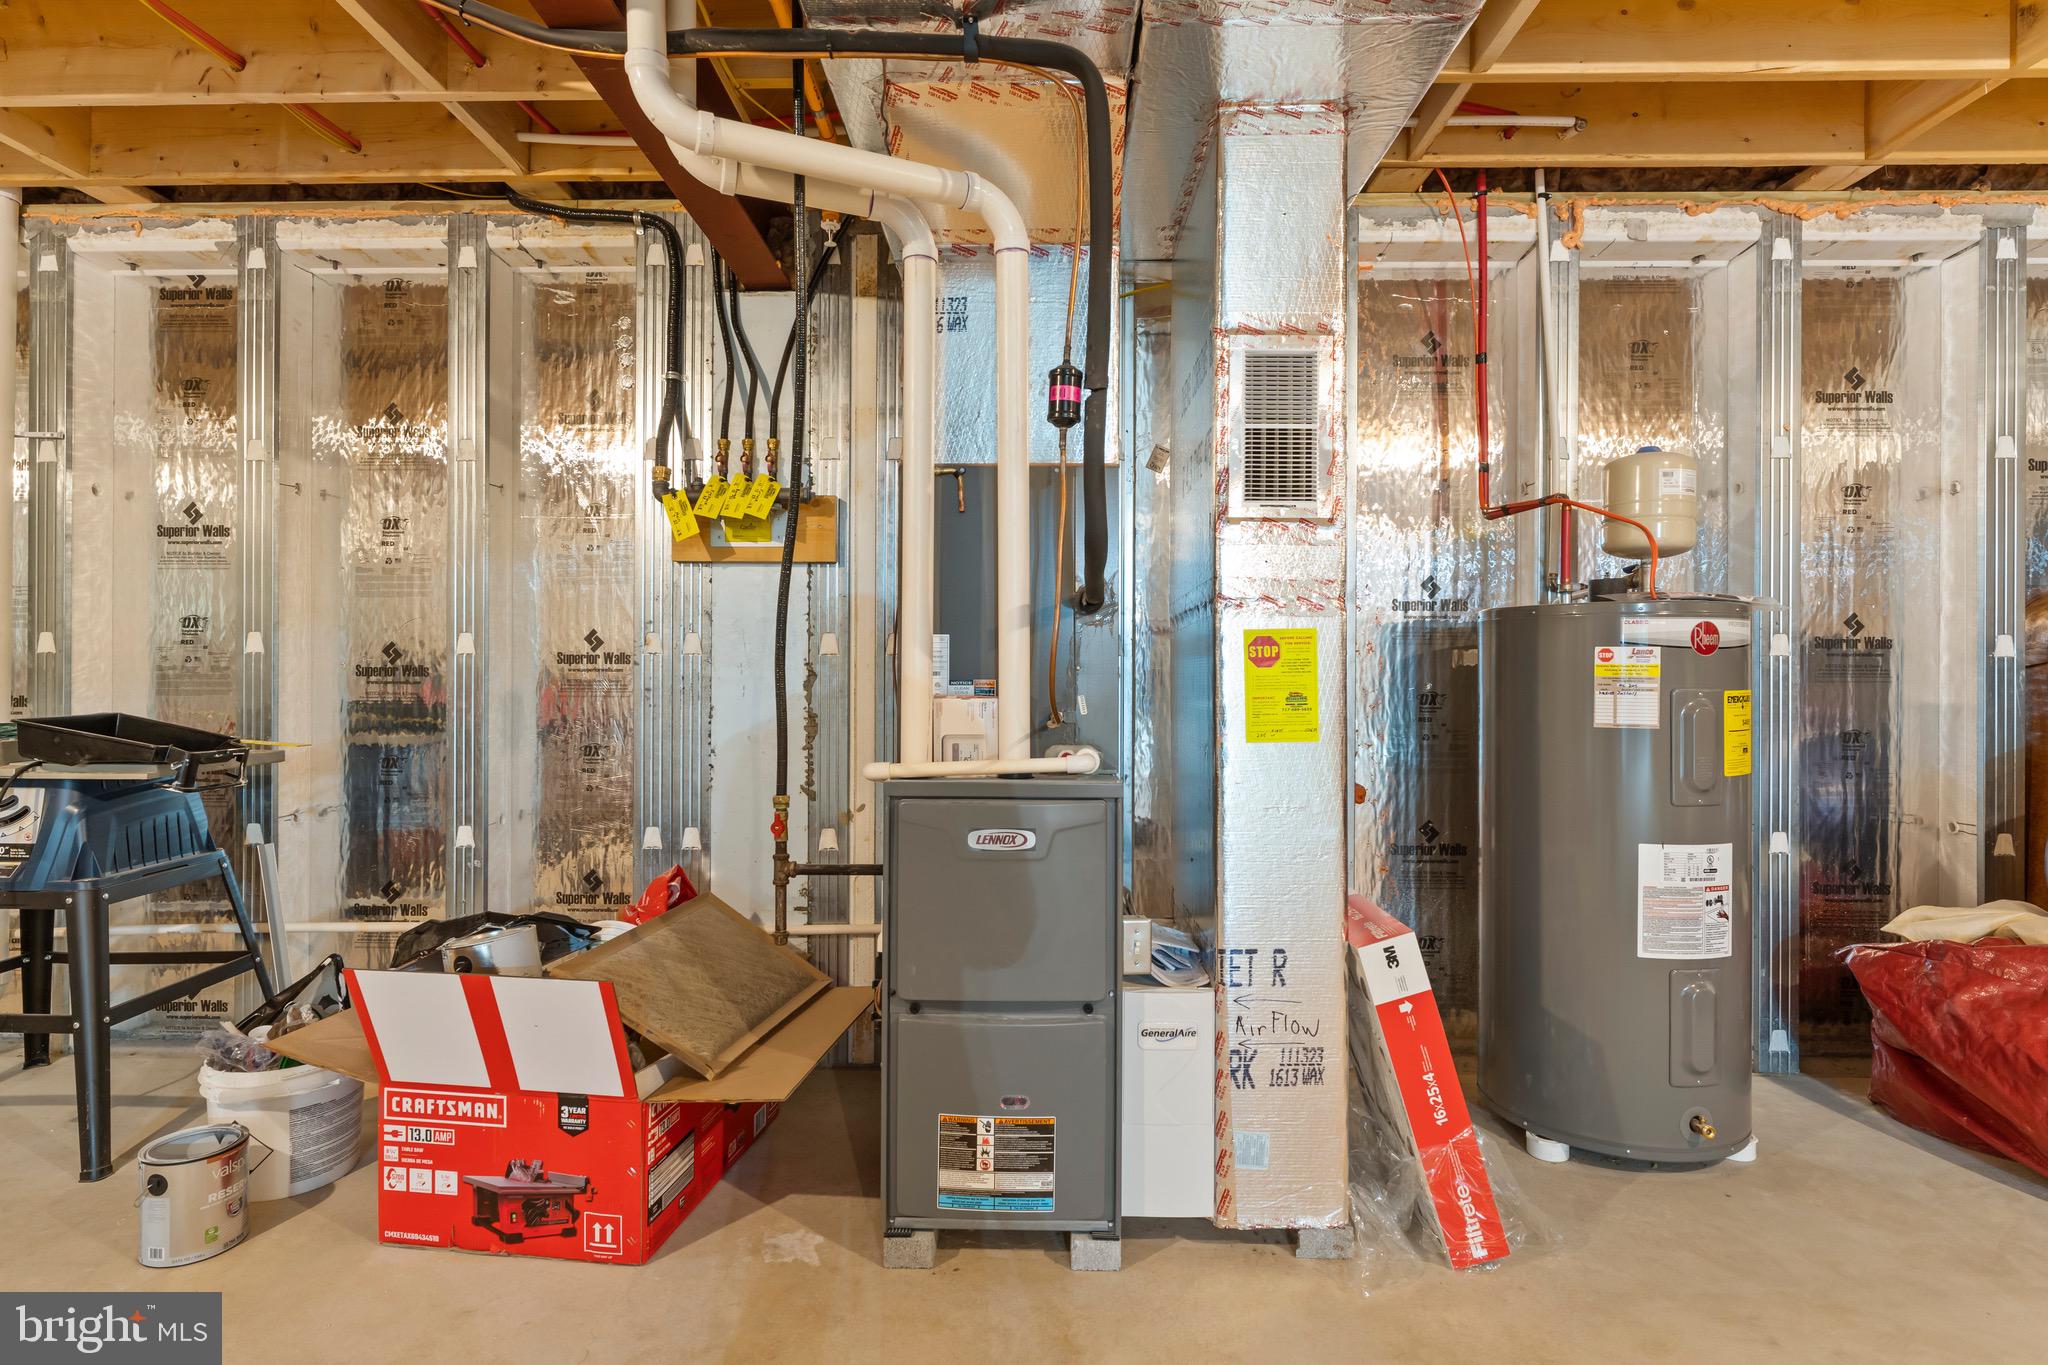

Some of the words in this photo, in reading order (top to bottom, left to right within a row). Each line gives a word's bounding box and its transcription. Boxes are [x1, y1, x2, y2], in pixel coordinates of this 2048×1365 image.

[159, 287, 203, 301] Superior
[205, 287, 233, 300] Walls
[1392, 354, 1438, 369] Superior
[1441, 354, 1470, 367] Walls
[1815, 390, 1862, 405] Superior
[1865, 390, 1893, 403] Walls
[356, 425, 401, 440] Superior
[156, 524, 200, 539] Superior
[202, 524, 230, 538] Walls
[1391, 599, 1438, 614] Superior
[1440, 599, 1469, 612] Walls
[182, 616, 200, 629] OX
[1814, 636, 1861, 651] Superior
[1864, 636, 1893, 650] Walls
[556, 651, 600, 666] Superior
[603, 651, 631, 665] Walls
[1249, 645, 1279, 658] STOP
[355, 664, 399, 679] Superior
[401, 664, 430, 677] Walls
[975, 834, 1018, 845] LENNOX
[1390, 843, 1436, 857] Superior
[1438, 843, 1467, 856] Walls
[555, 892, 599, 906] Superior
[602, 892, 631, 905] Walls
[353, 903, 397, 918] Superior
[400, 903, 428, 916] Walls
[1383, 945, 1401, 970] 3M
[1272, 948, 1288, 987] R
[200, 999, 229, 1013] Walls
[1141, 1027, 1197, 1038] GeneralAire
[1269, 1068, 1299, 1087] 1613
[391, 1096, 498, 1120] CRAFTSMAN
[560, 1105, 569, 1118] 3
[569, 1106, 587, 1114] YEAR
[560, 1117, 587, 1125] WARRANTY
[409, 1127, 433, 1143] 13.0
[434, 1130, 453, 1143] AMP
[1456, 1184, 1489, 1259] Filtrete
